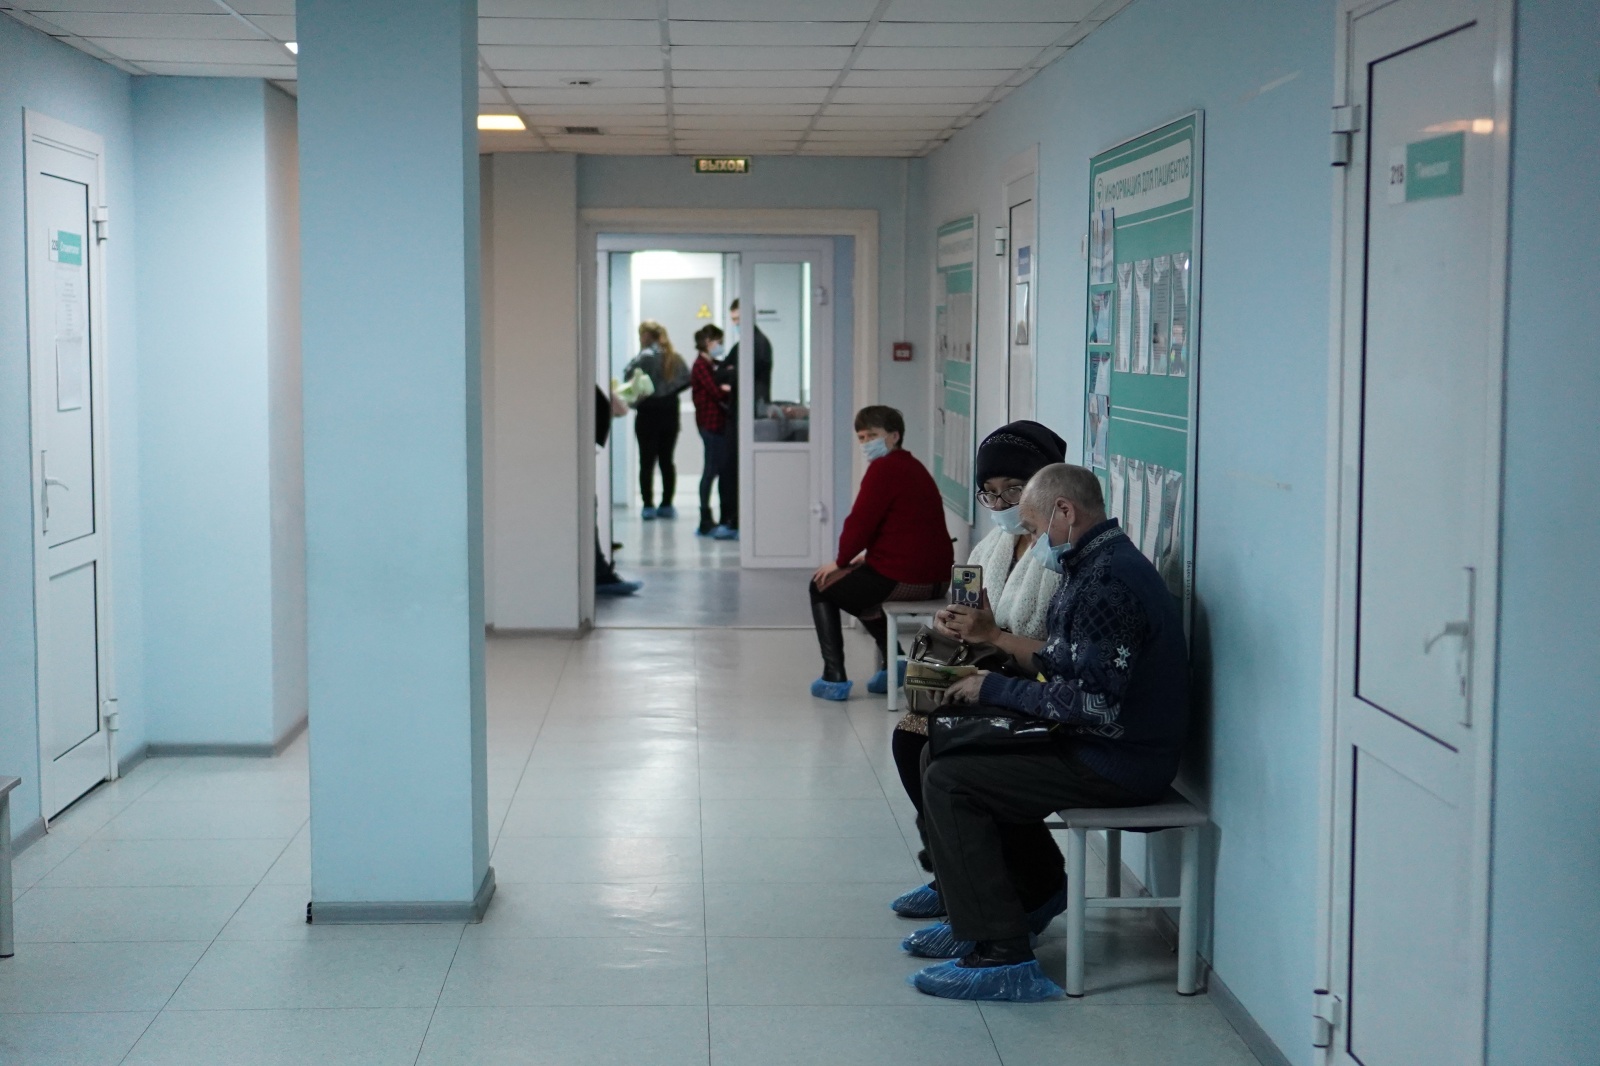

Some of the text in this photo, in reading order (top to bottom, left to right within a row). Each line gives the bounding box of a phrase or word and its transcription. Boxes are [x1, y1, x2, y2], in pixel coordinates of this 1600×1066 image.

[699, 159, 745, 172] ВЫХОД
[1105, 155, 1190, 203] ИНФОРМАЦИЯ ДЛЯ ПАЦИЕНТОВ
[954, 588, 980, 603] LO
